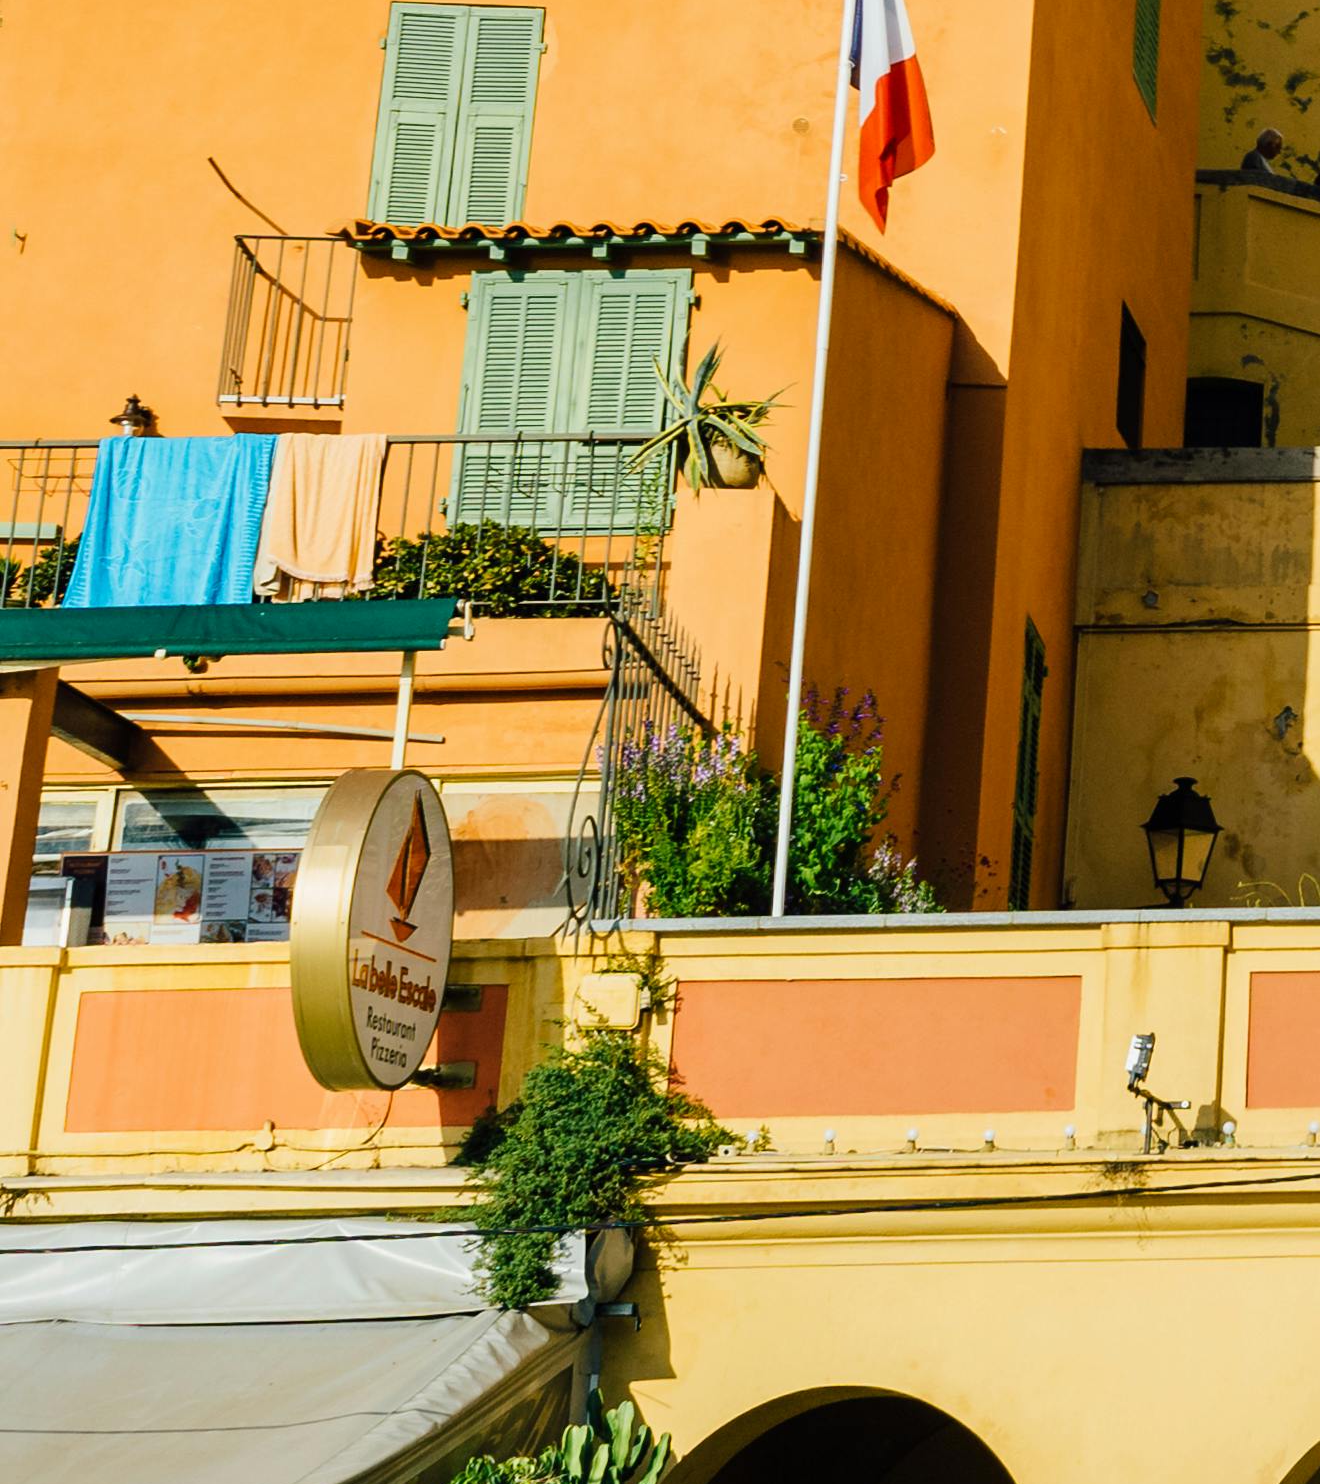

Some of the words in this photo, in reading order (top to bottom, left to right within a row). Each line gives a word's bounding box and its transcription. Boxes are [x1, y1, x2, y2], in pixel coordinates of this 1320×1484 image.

[352, 948, 368, 990] La
[369, 954, 398, 1000] belle
[398, 966, 436, 1013] Escale
[366, 1006, 416, 1042] Restaurant
[370, 1036, 407, 1068] Pizzeria
